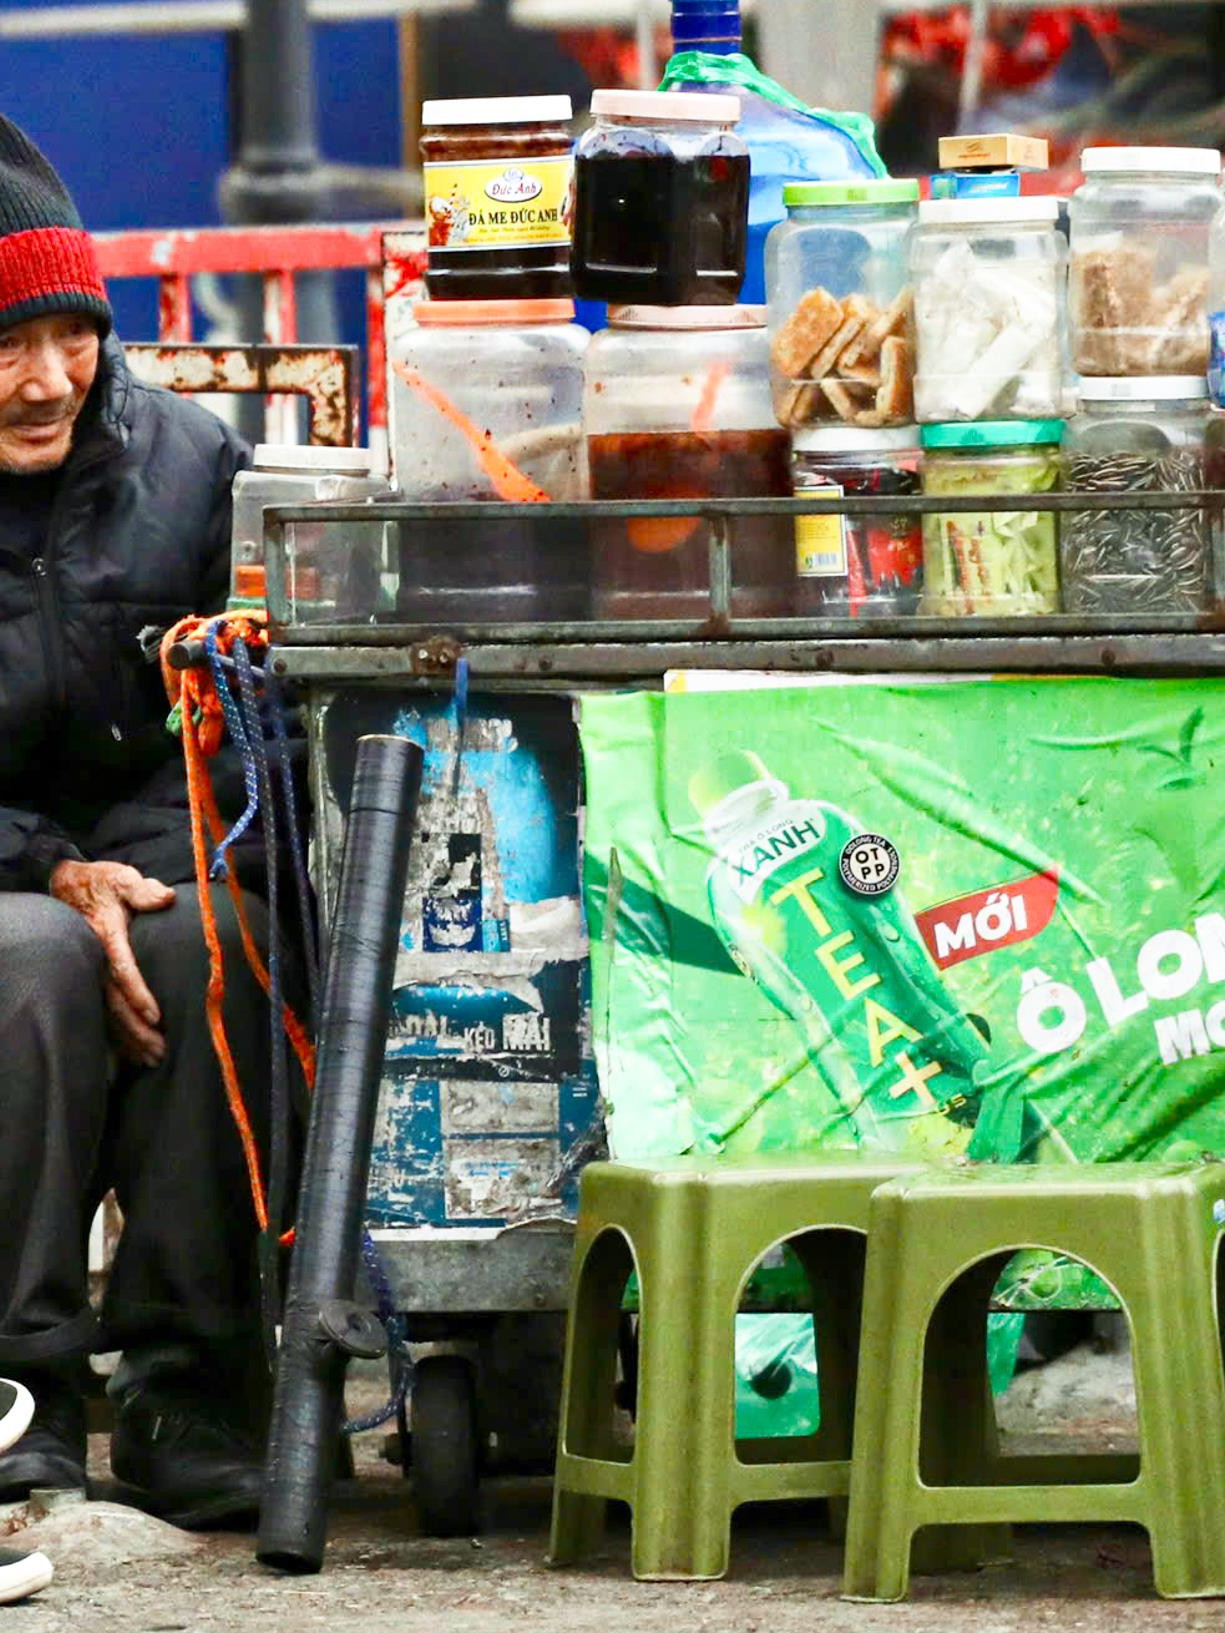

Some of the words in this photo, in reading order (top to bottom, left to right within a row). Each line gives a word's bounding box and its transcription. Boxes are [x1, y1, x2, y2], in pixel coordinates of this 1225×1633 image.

[469, 209, 486, 226] ĐÁ
[488, 211, 508, 225] ME
[510, 207, 536, 224] ĐỨC
[538, 208, 558, 222] ANH
[732, 820, 821, 885] XANH
[933, 892, 1028, 958] MỚI
[1016, 966, 1087, 1051] Ô
